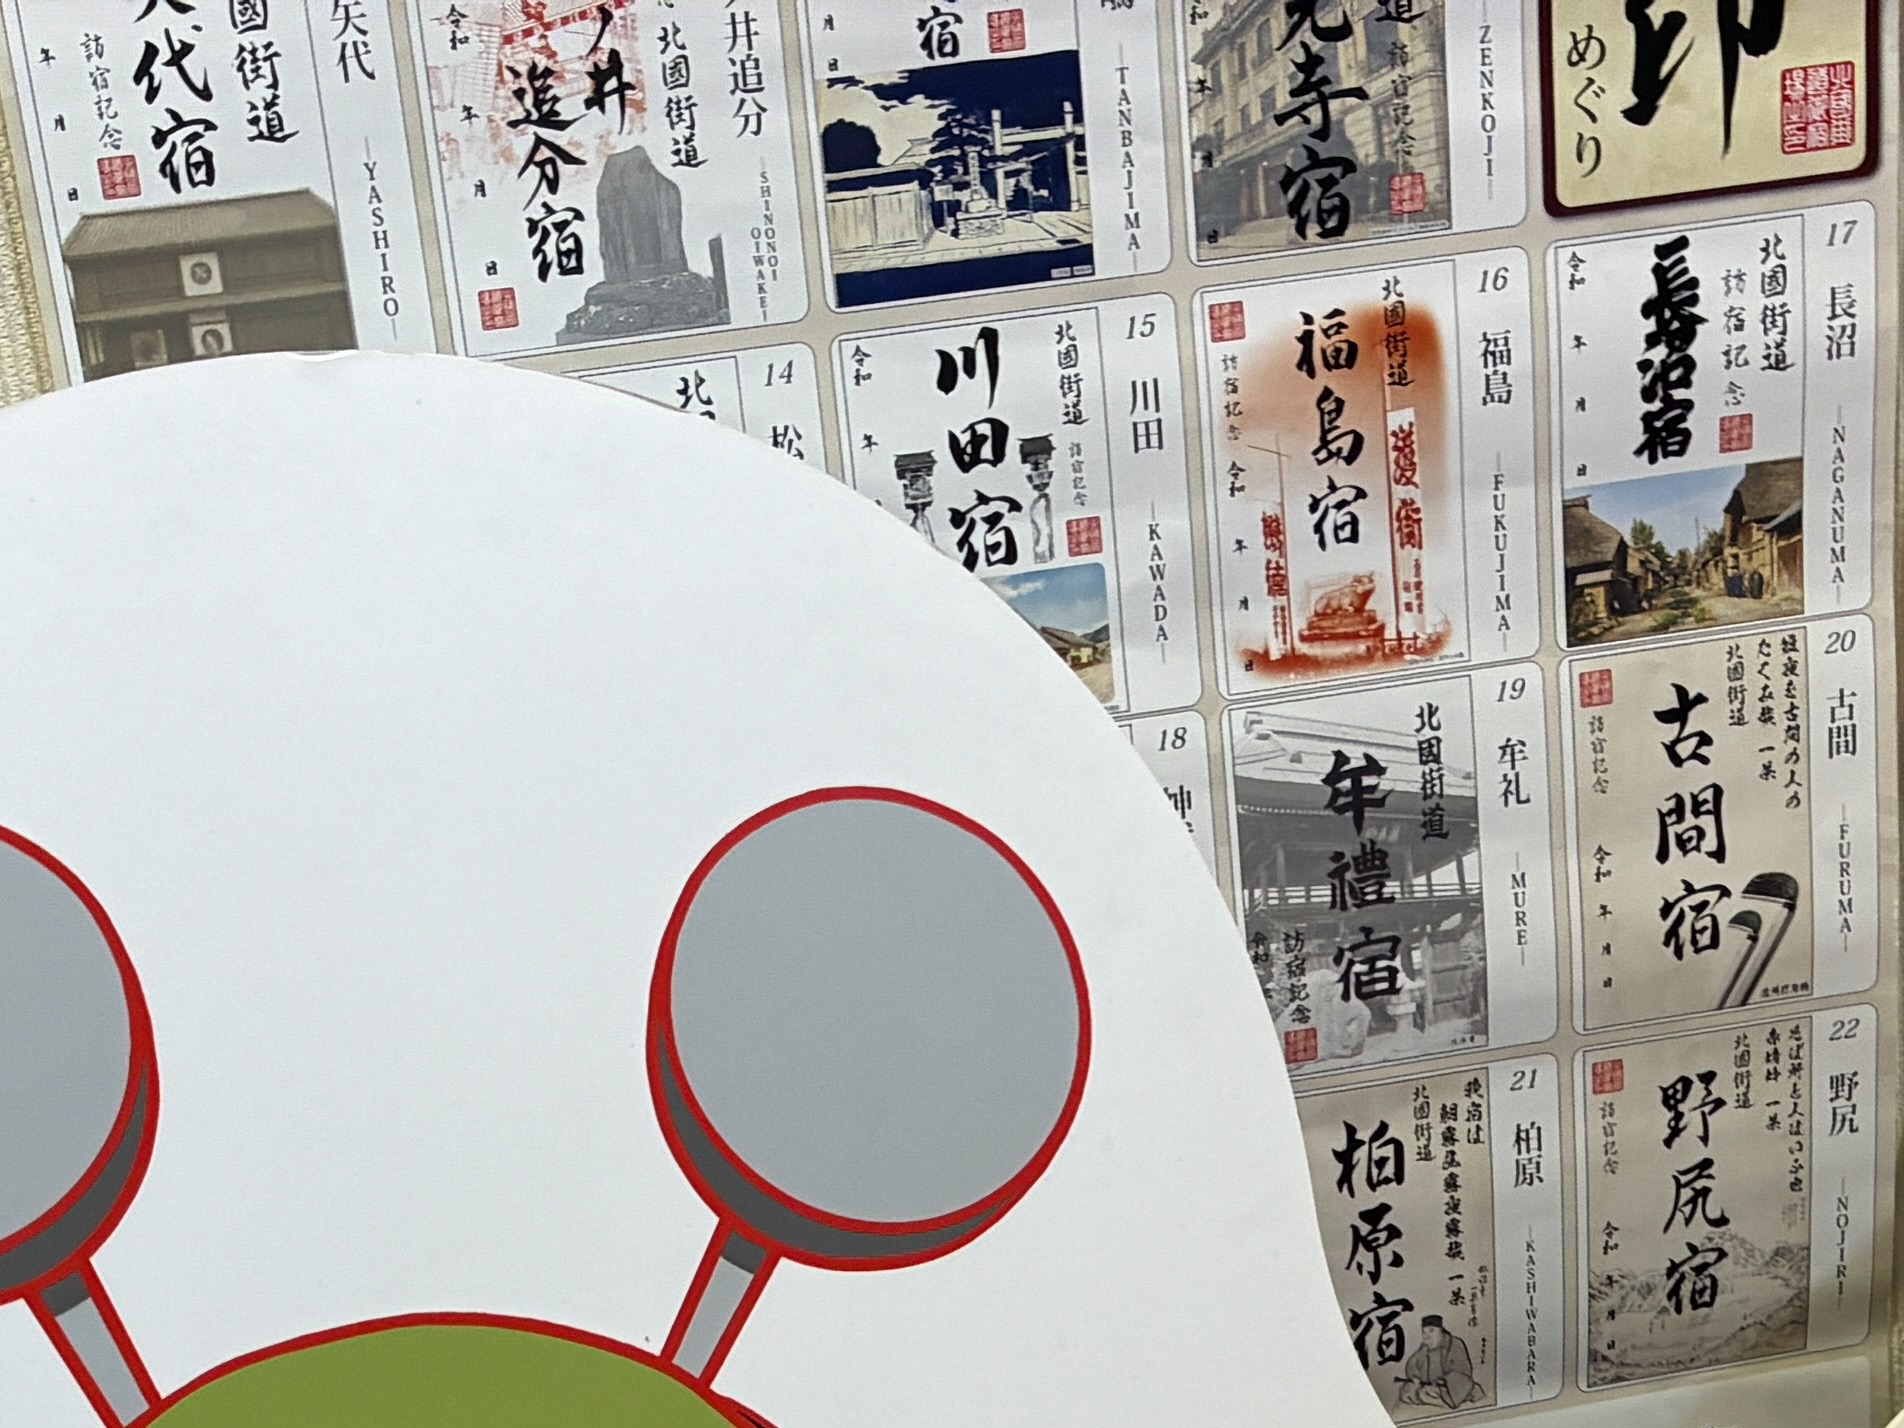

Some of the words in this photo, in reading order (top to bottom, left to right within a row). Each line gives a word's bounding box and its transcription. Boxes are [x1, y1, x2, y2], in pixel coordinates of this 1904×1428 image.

[1479, 25, 1497, 177] ZENKOJI
[1567, 24, 1606, 179] めぐり
[1114, 66, 1141, 251] TANBAJIMA
[363, 161, 399, 318] YASHIRO
[1826, 219, 1858, 247] 17
[1478, 266, 1509, 293] 16
[1125, 313, 1158, 340] 15
[1825, 282, 1858, 361] 長沼
[764, 360, 795, 387] 14
[1479, 328, 1514, 407] 福島
[933, 326, 1023, 573] 川田宿
[1128, 376, 1164, 454] 川田
[1295, 307, 1367, 552] 福島宿
[1831, 425, 1847, 584] NAGANUMA
[1148, 523, 1169, 643] KAWADA
[1492, 473, 1512, 632] FUKUJIMA
[1823, 629, 1857, 655] 20
[1496, 677, 1527, 703] 19
[1826, 687, 1858, 760] 古間
[1157, 726, 1188, 752] 18
[1497, 736, 1530, 808] 牟礼
[1652, 681, 1732, 961] 古間宿
[1510, 872, 1528, 946] MURE
[1838, 824, 1852, 934] FURUMA
[1828, 1018, 1861, 1042] 22
[1509, 1068, 1538, 1092] 21
[1828, 1071, 1859, 1137] 野尻
[1511, 1120, 1545, 1190] 柏原
[1657, 1069, 1731, 1315] 野尻宿
[1330, 1119, 1415, 1370] 柏原宿
[1835, 1196, 1850, 1296] NOJIRI
[1524, 1239, 1538, 1387] KASHIWABARA
